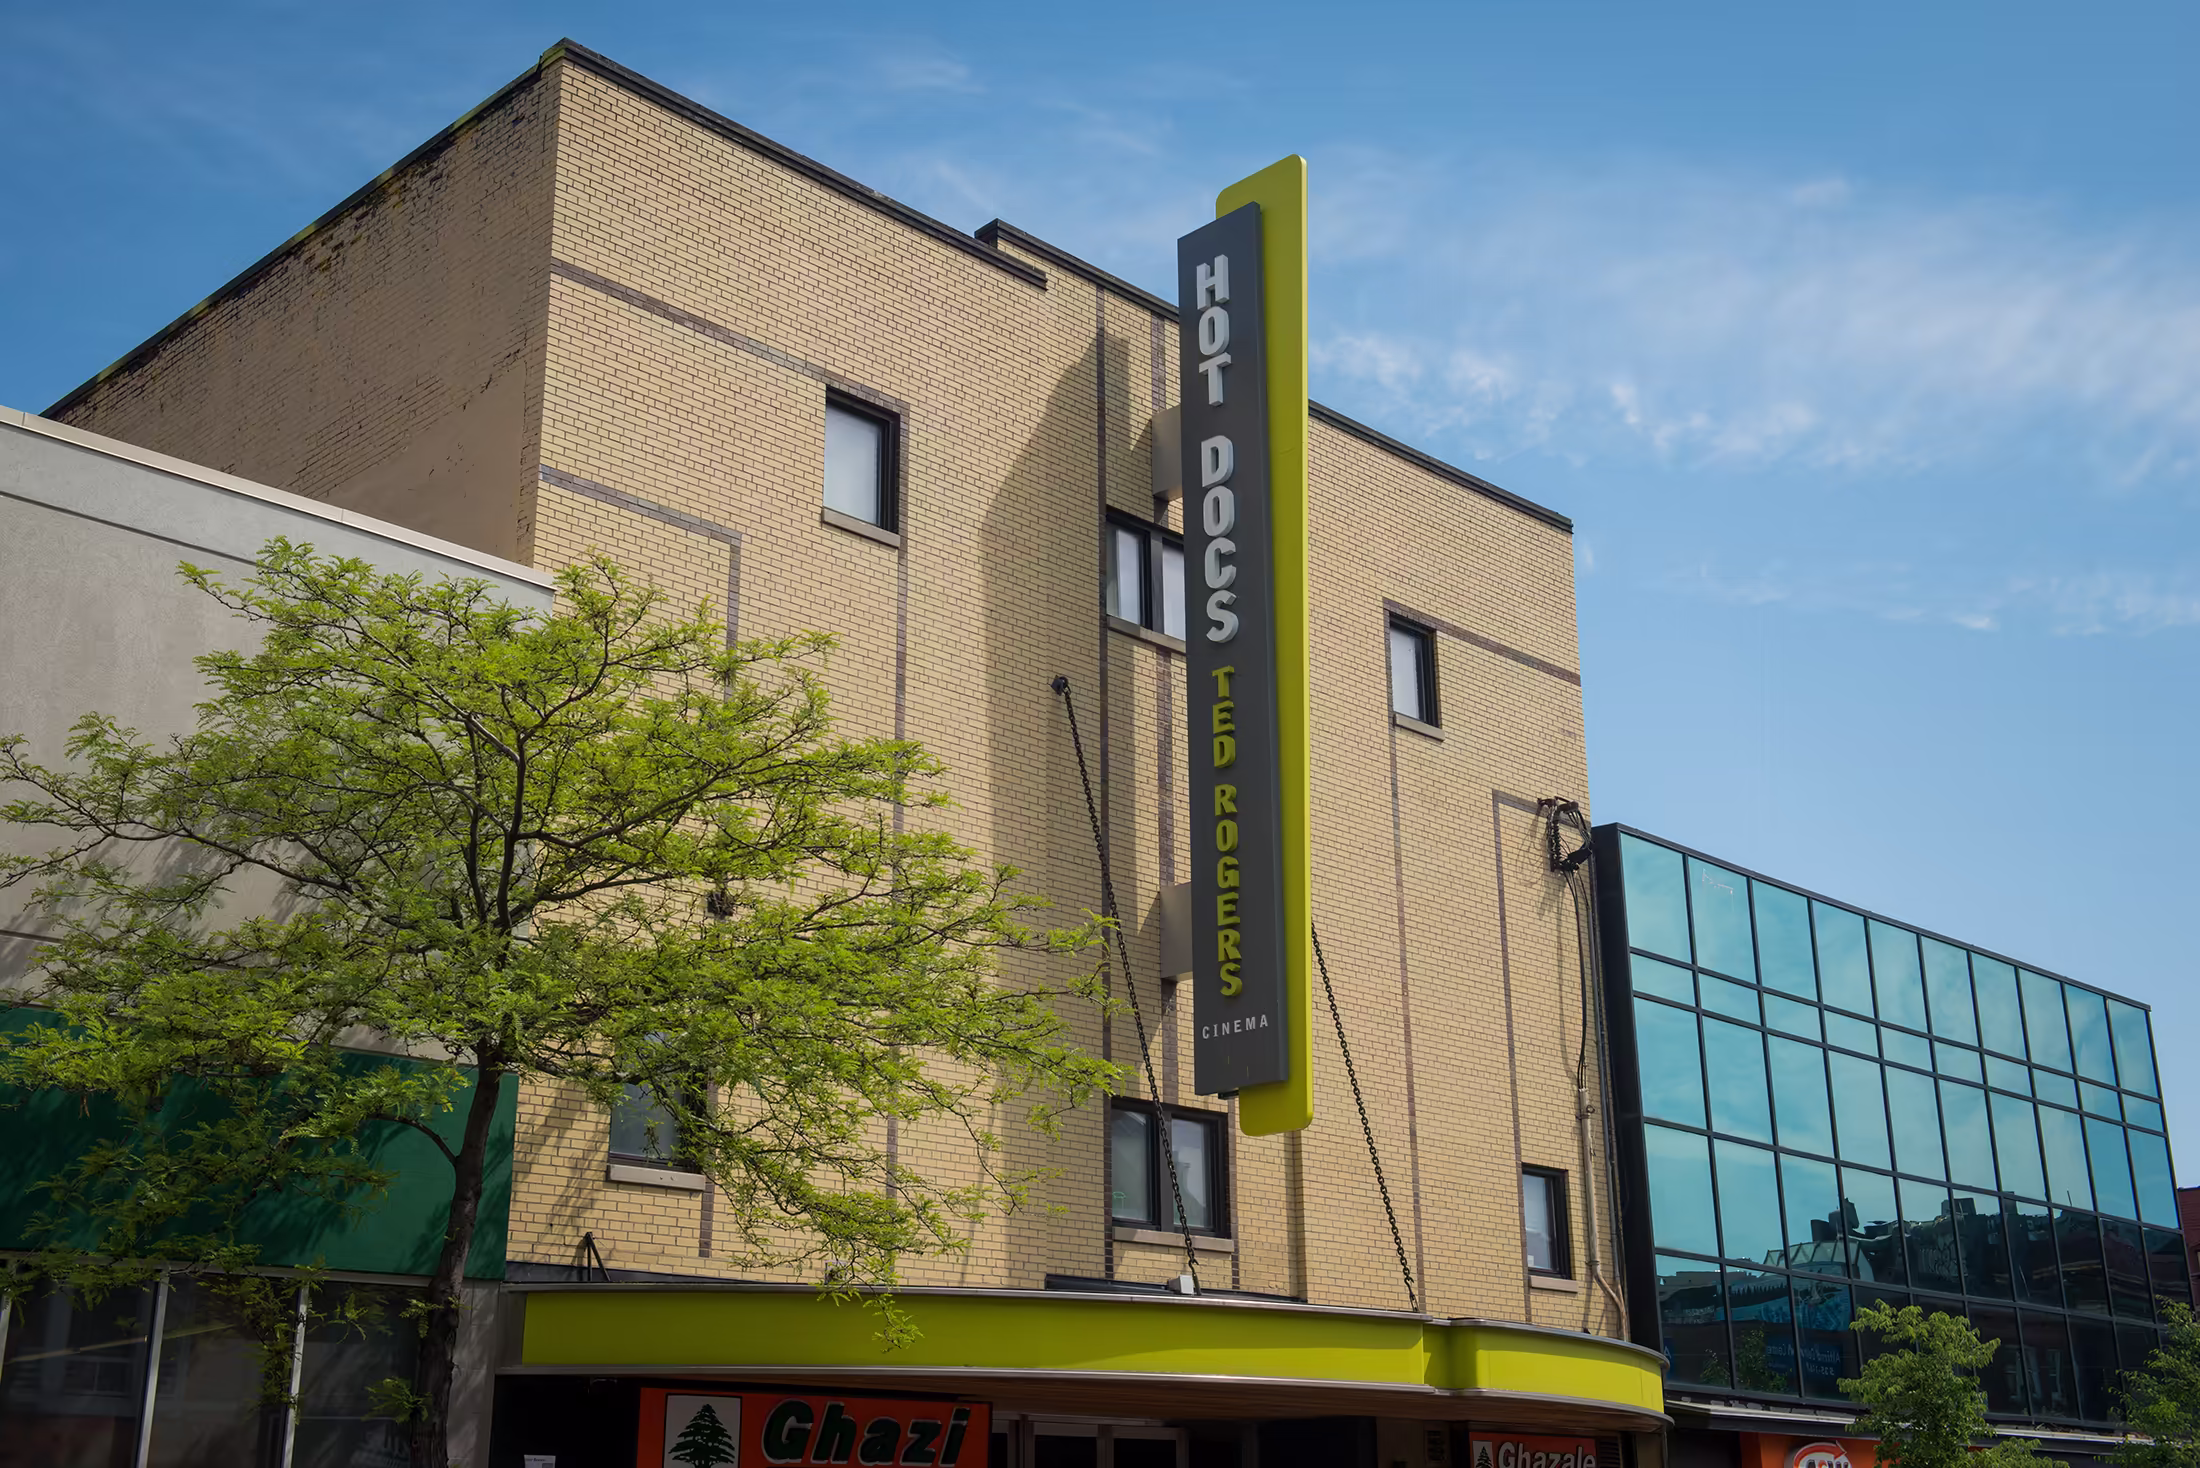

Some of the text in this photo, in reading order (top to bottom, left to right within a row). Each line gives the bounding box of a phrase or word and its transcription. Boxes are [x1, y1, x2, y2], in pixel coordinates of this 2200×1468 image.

[1196, 254, 1239, 643] HOT DOCS
[1212, 665, 1242, 997] TED ROGERS
[1202, 1014, 1268, 1039] CINEMA
[760, 1397, 971, 1467] Ghazi
[1498, 1441, 1596, 1468] Ghazale
